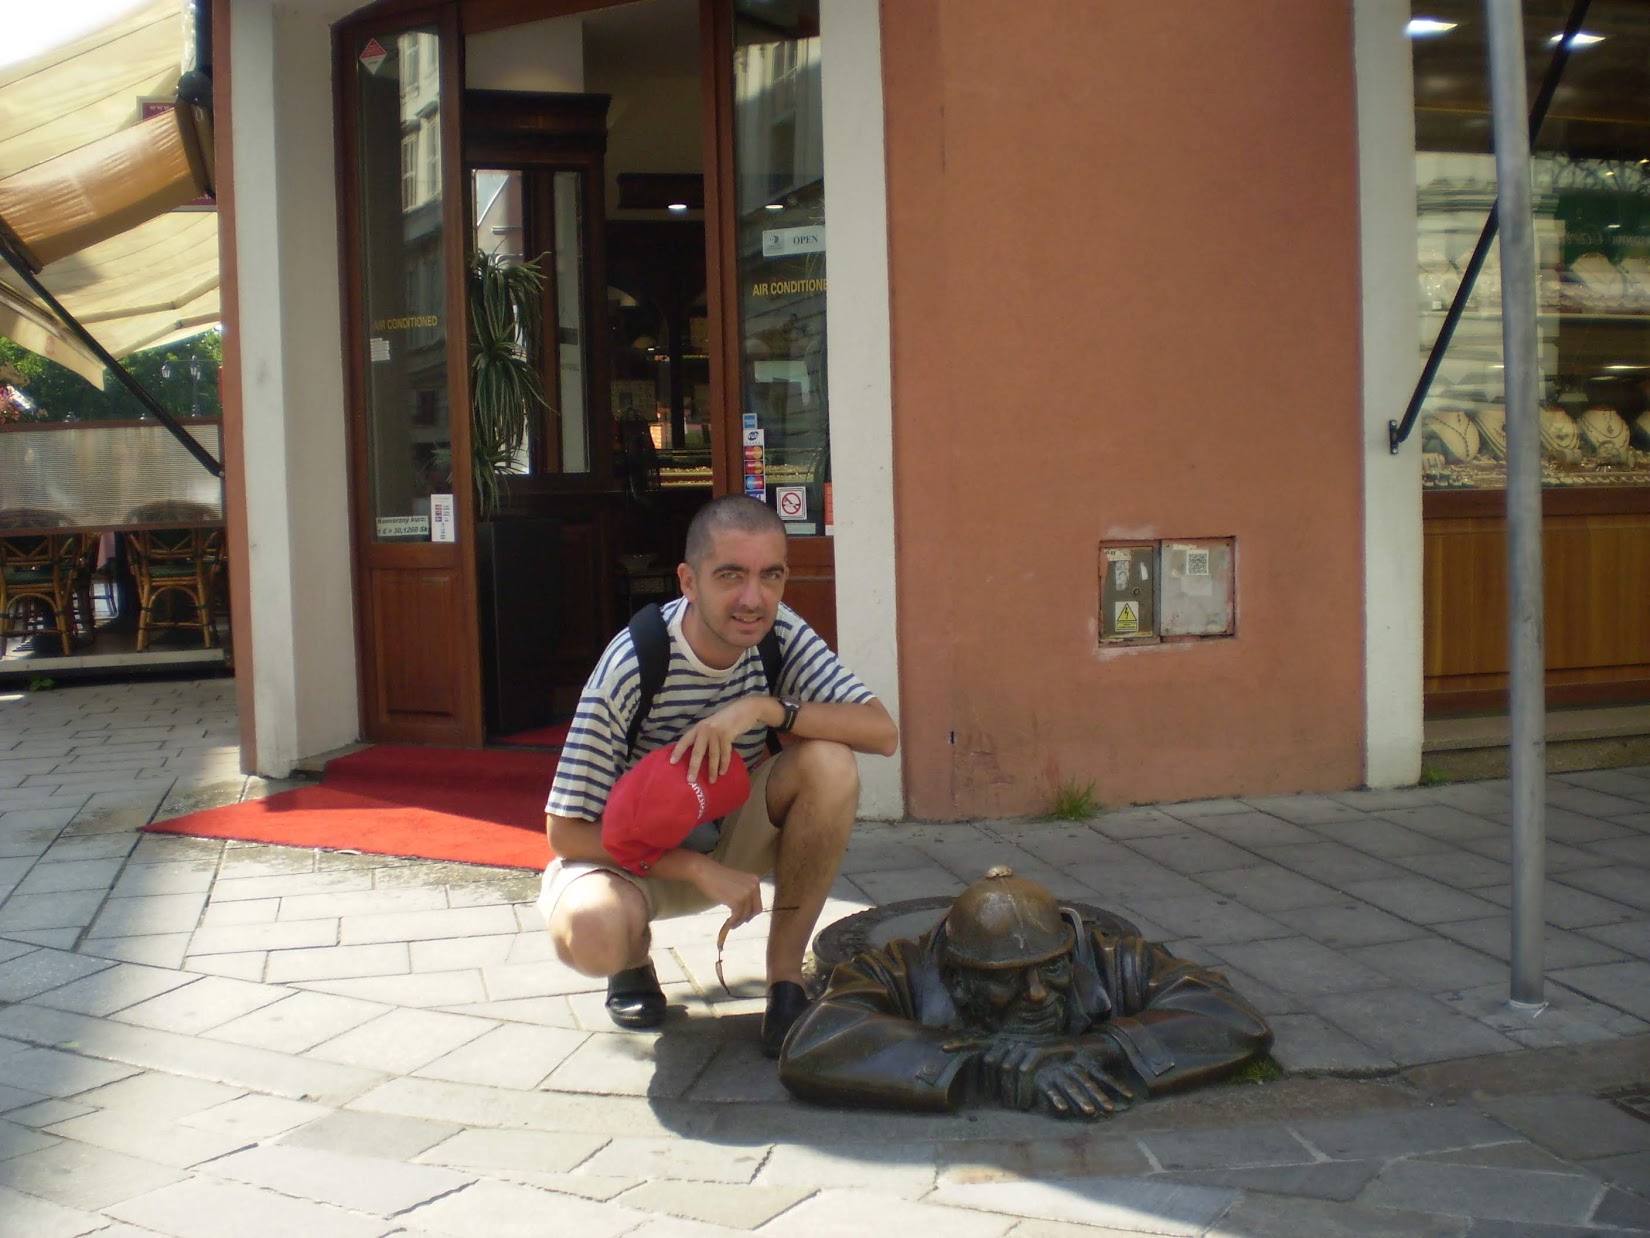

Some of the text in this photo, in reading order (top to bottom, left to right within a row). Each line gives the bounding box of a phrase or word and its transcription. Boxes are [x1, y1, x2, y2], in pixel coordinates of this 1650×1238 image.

[793, 235, 818, 245] OPEN
[752, 278, 827, 296] AIR CONDITIONE
[387, 316, 438, 329] CONDITIONED
